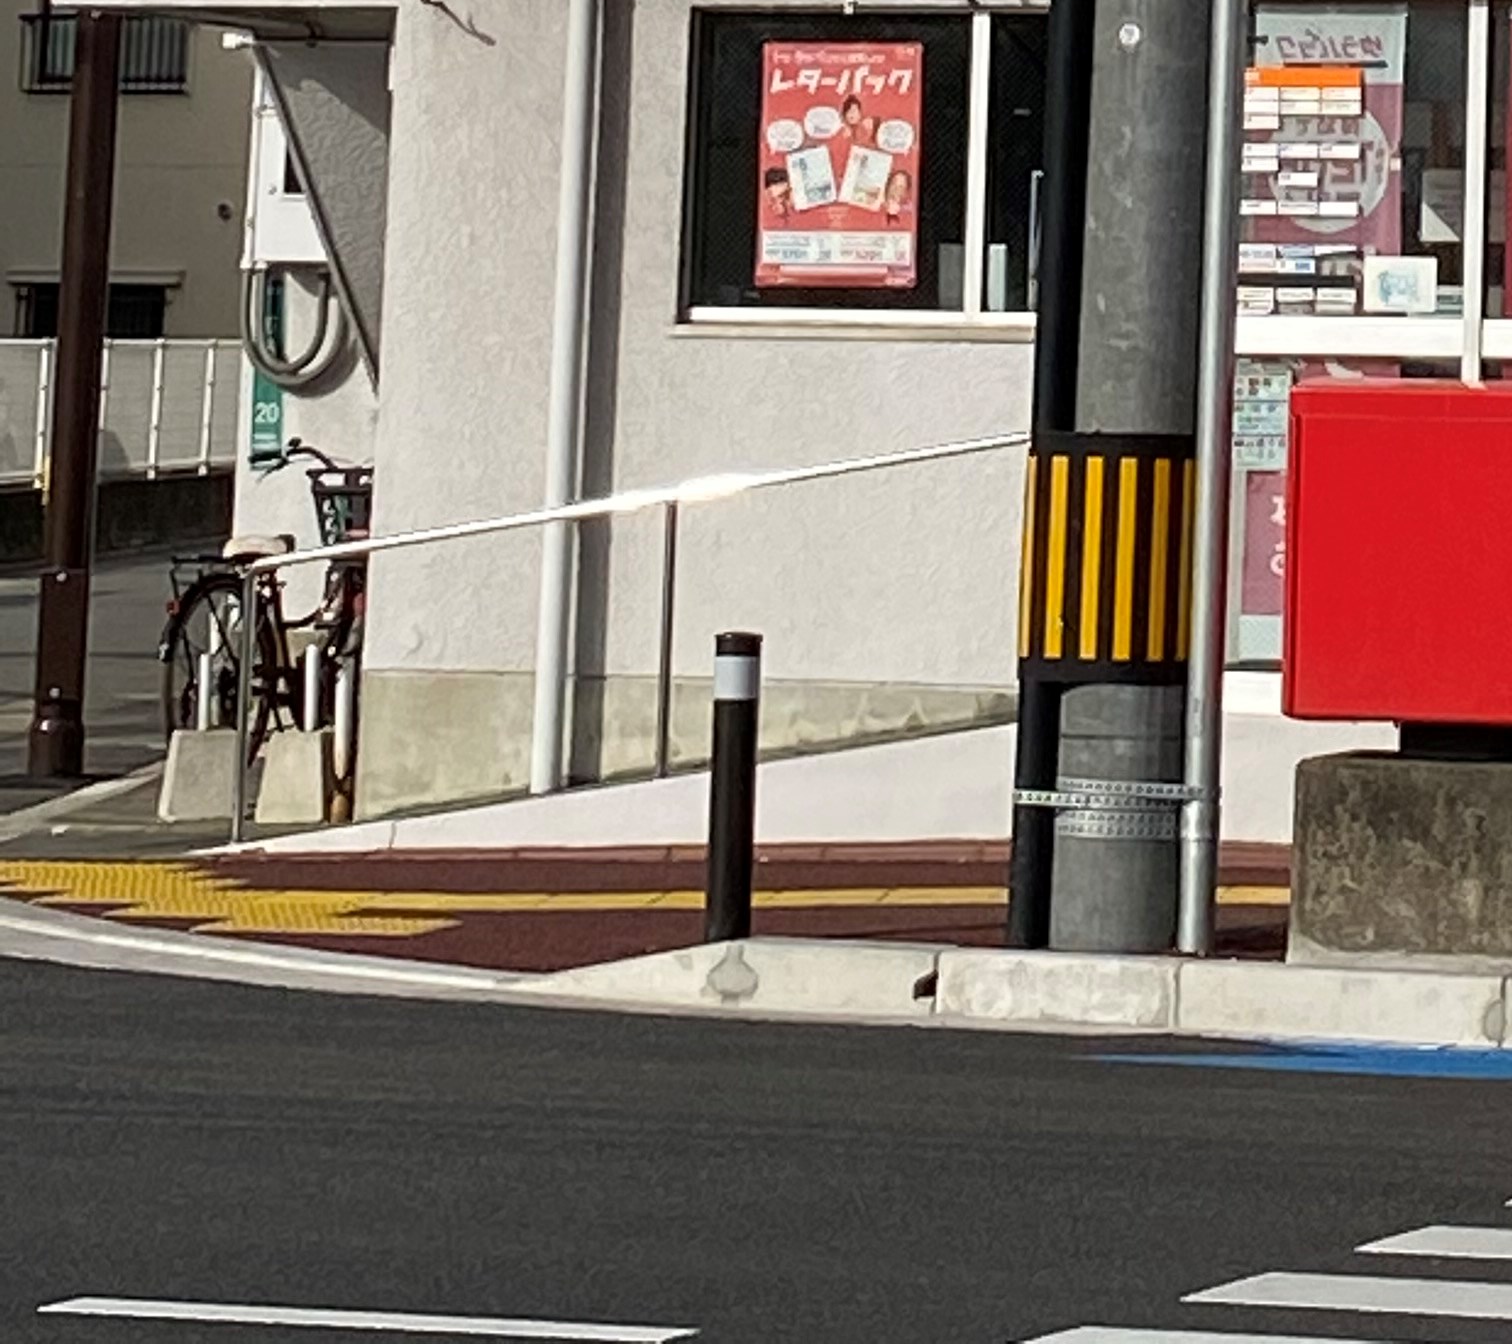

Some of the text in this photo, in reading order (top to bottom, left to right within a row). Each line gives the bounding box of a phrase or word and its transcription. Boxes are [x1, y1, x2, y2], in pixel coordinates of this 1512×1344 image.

[769, 65, 913, 96] レターパック
[254, 402, 280, 424] 20
